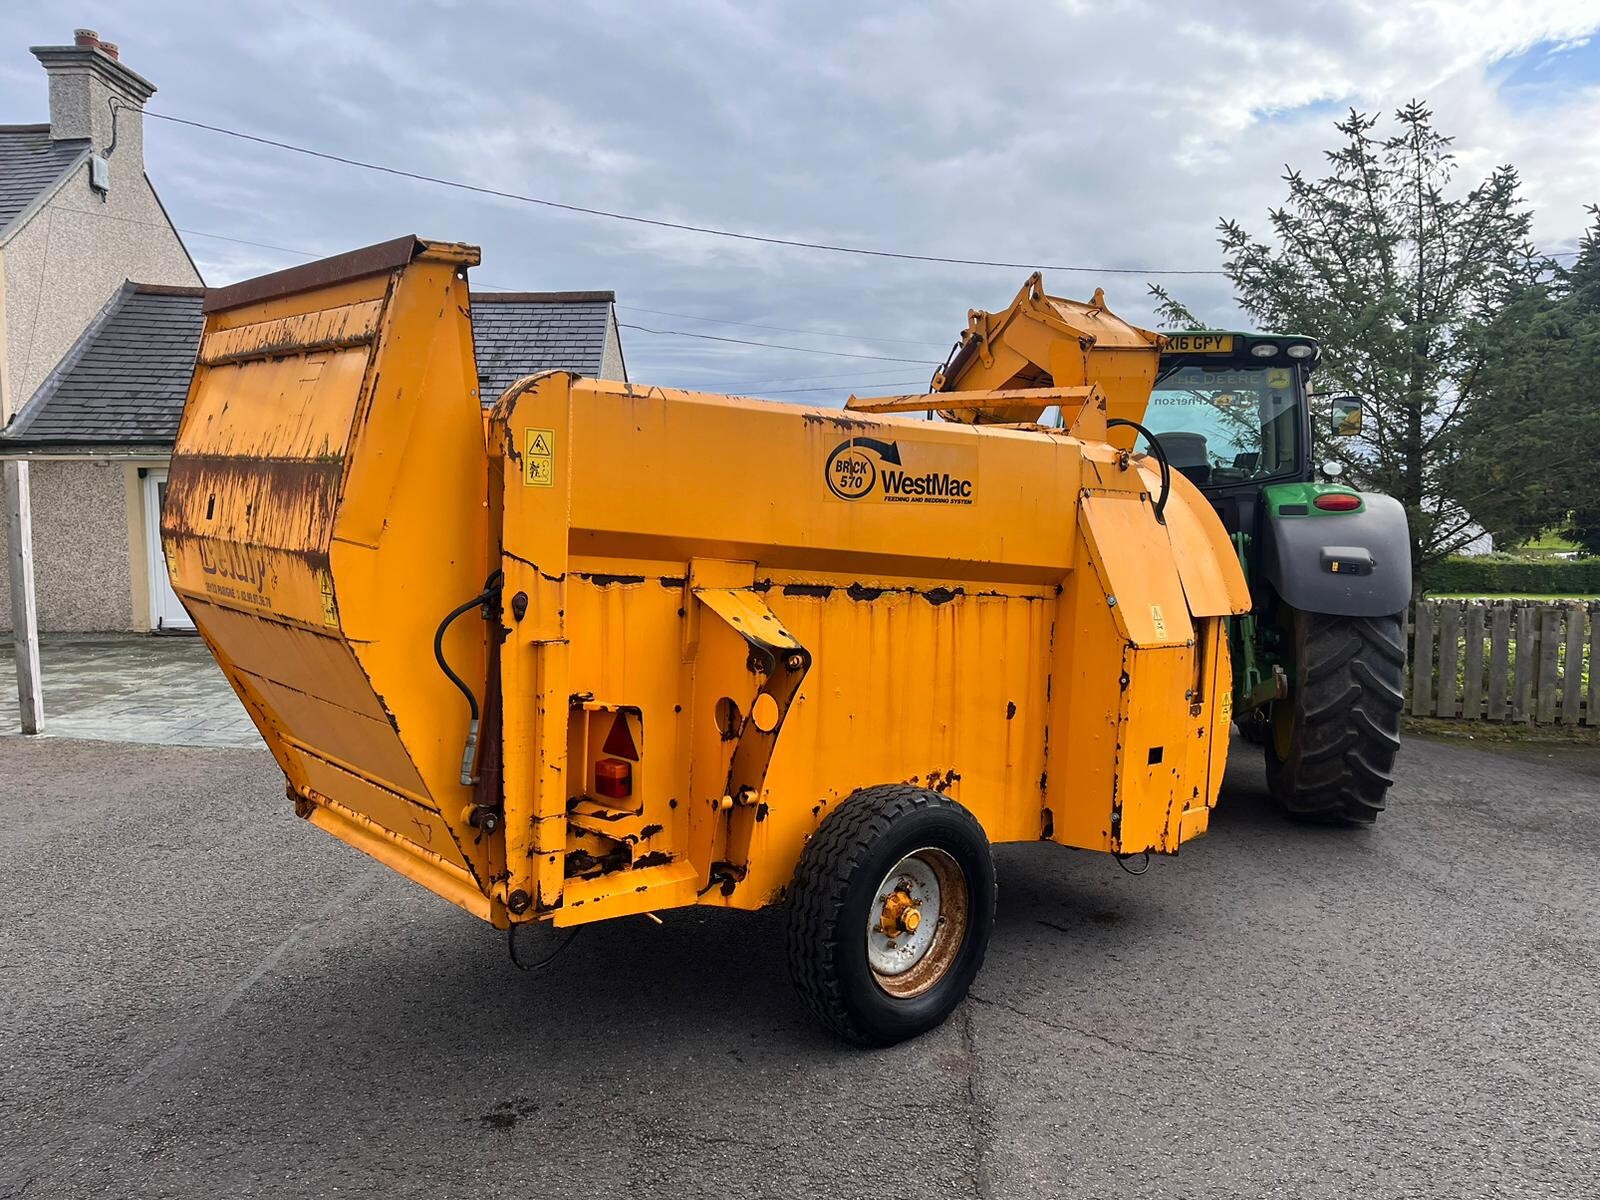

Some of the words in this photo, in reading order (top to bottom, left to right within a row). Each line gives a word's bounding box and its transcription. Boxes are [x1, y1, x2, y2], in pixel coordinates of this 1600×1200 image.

[1164, 336, 1189, 350] K16
[1193, 336, 1224, 350] GPY
[1204, 373, 1260, 385] DEERE
[839, 475, 863, 489] 570
[881, 469, 972, 497] WestMac
